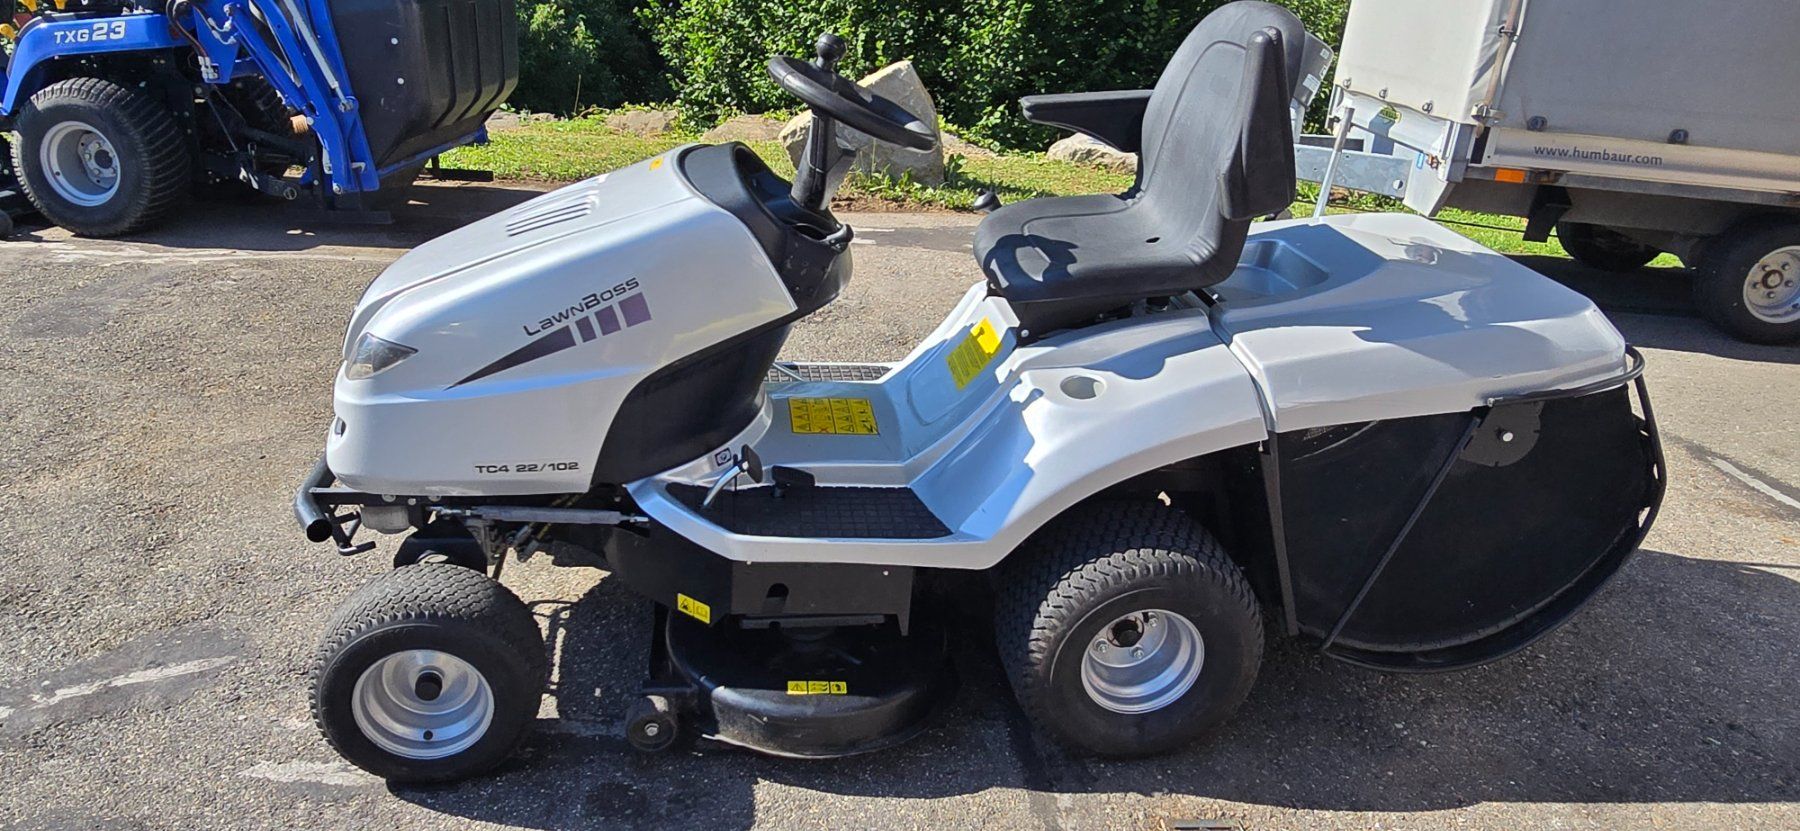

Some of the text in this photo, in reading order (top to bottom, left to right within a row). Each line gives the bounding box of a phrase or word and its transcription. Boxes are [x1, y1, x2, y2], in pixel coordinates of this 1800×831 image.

[1534, 146, 1663, 165] www.humbaur.com
[475, 462, 579, 473] TC4 22/102
